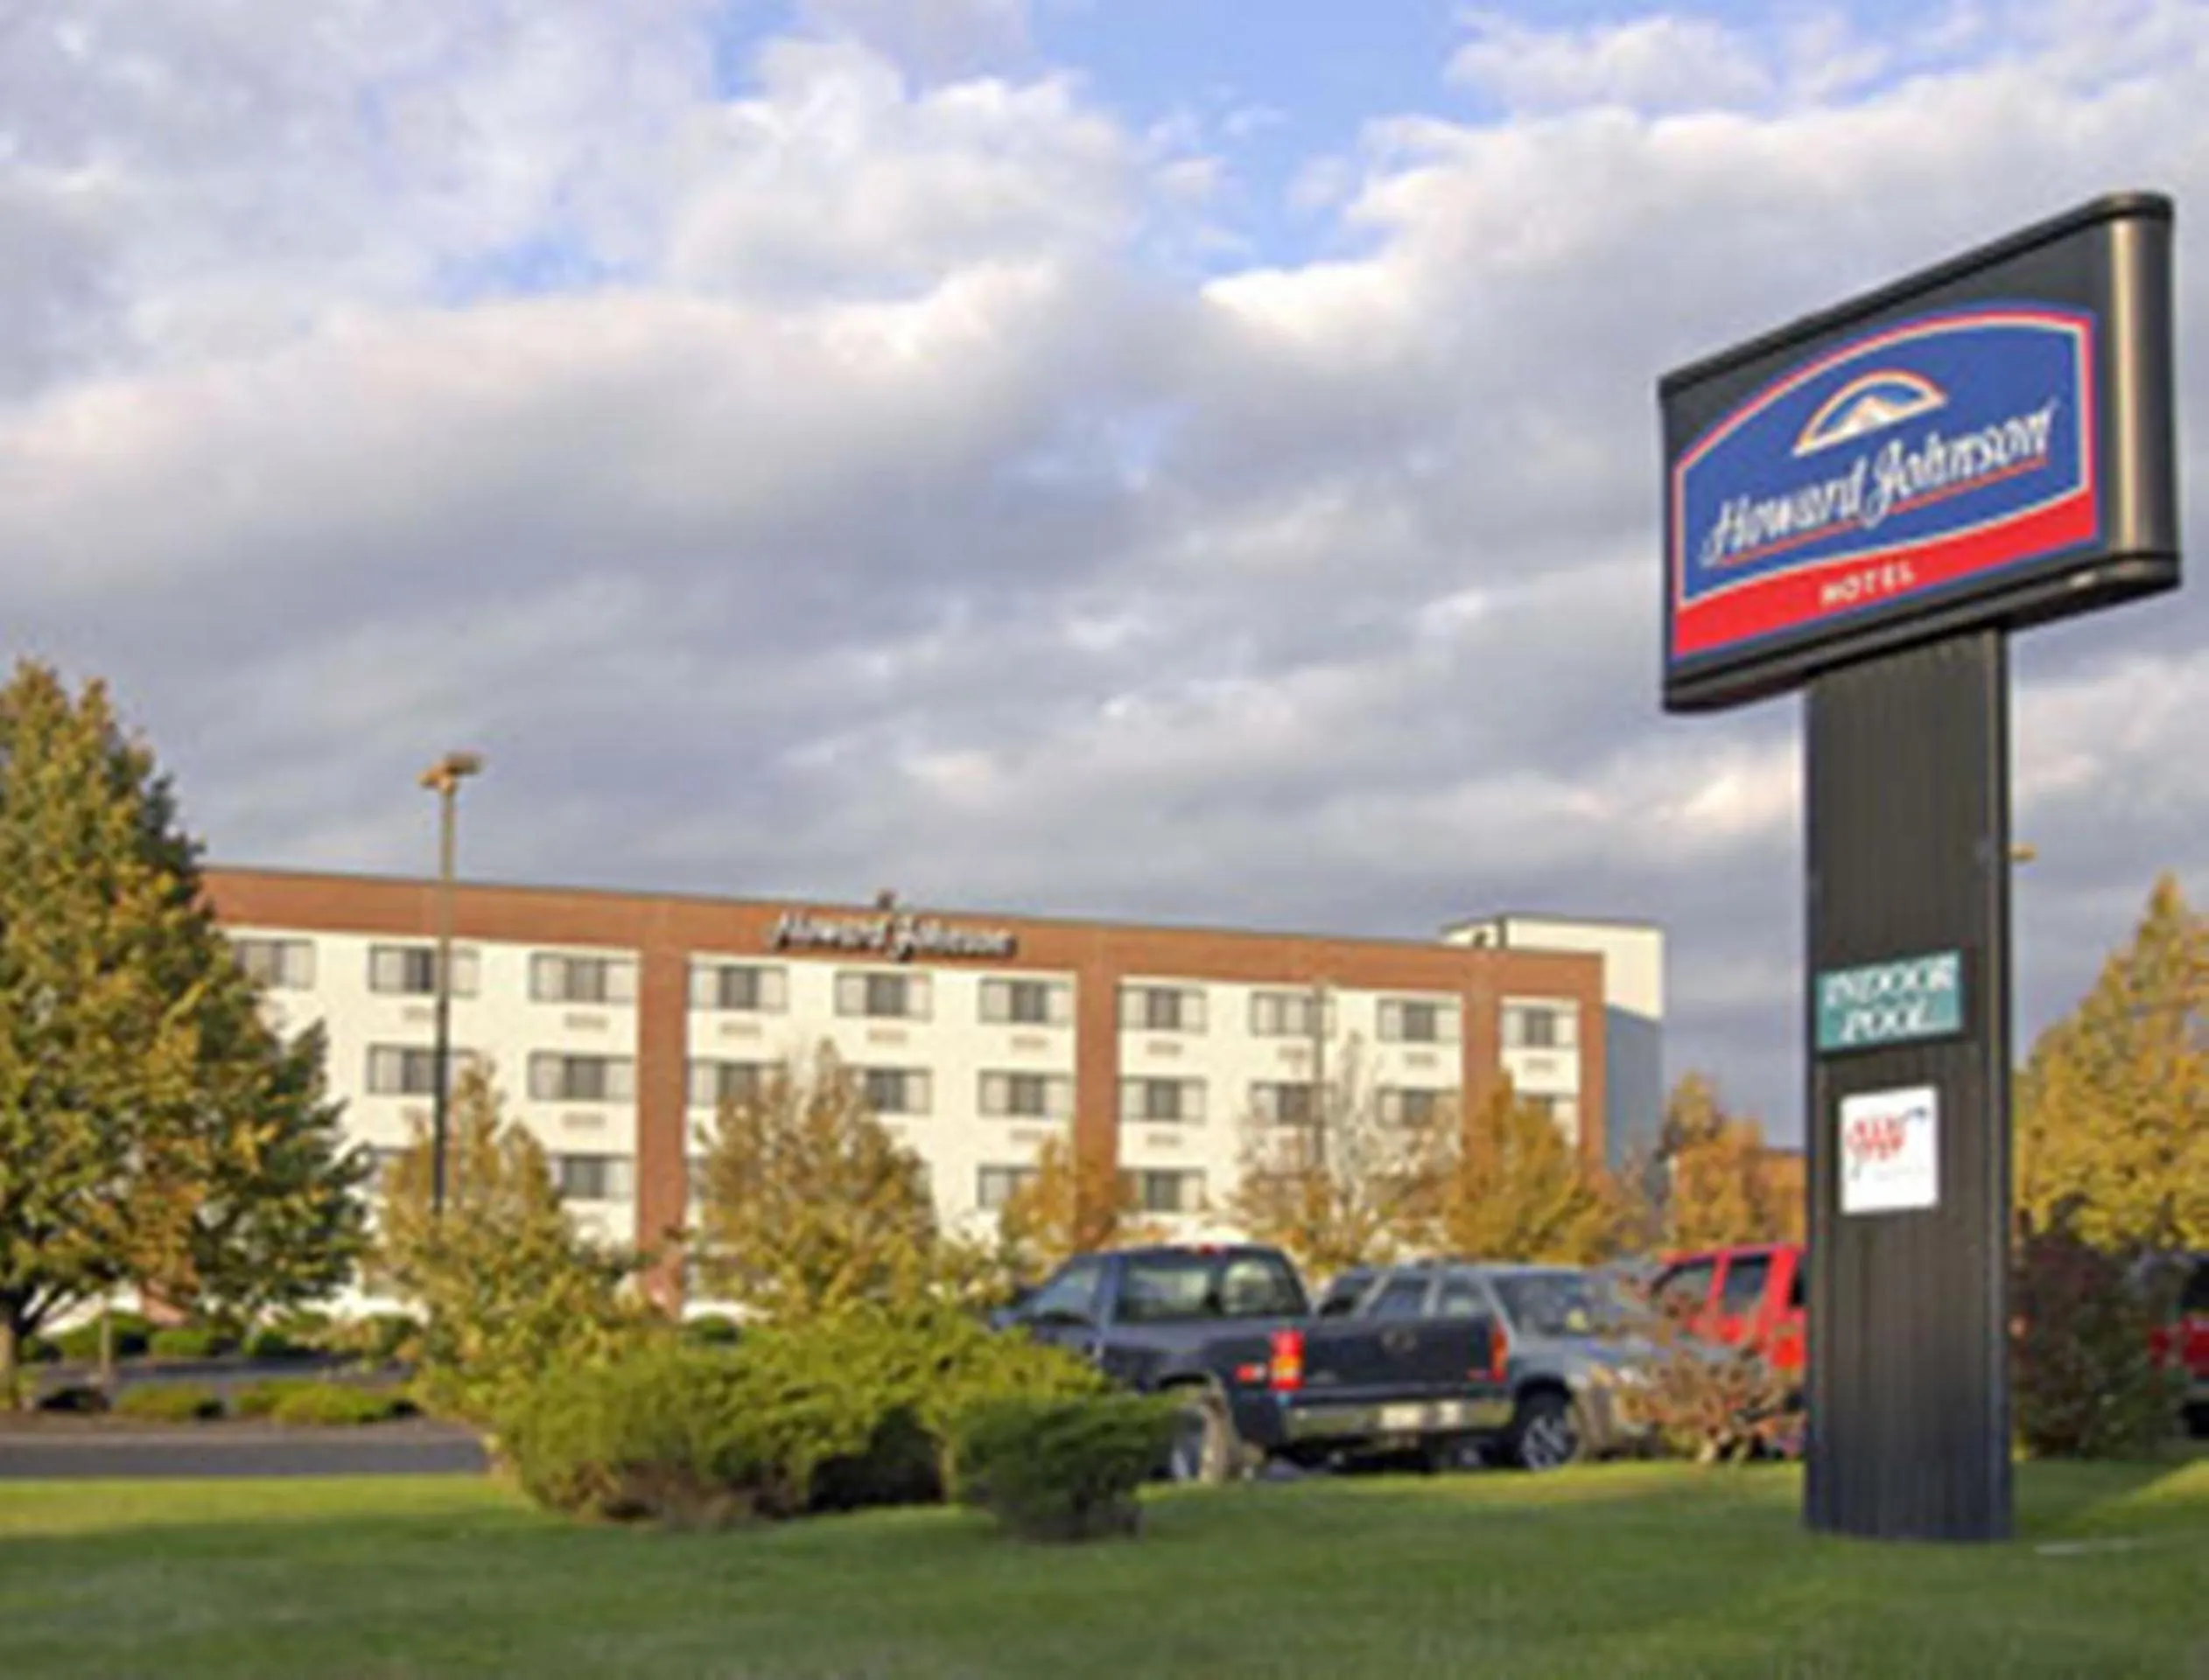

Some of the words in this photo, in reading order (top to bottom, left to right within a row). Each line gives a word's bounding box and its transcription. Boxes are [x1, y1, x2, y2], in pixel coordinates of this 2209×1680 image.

[1701, 456, 1868, 567] Howard
[1863, 396, 2060, 528] Johnson
[1820, 561, 1917, 606] HOTEL
